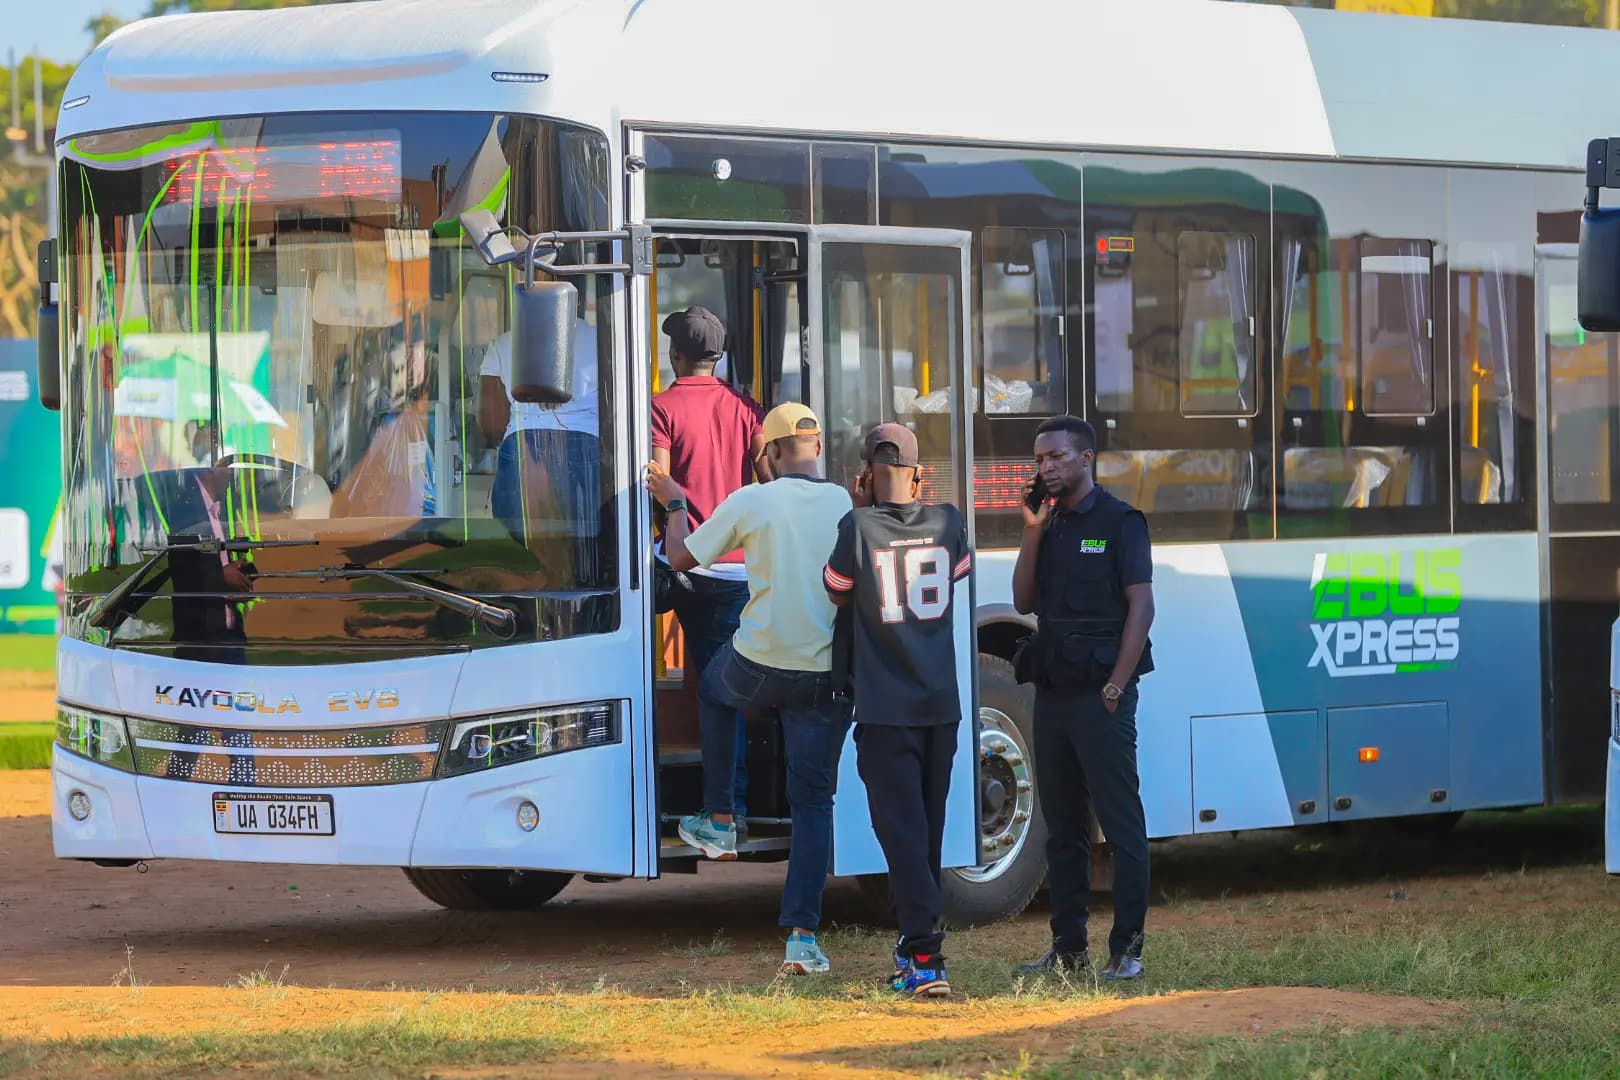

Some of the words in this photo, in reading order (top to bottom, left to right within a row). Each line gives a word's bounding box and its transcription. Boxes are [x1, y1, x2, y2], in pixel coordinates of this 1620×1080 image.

[872, 546, 950, 624] 18
[1310, 548, 1462, 620] EBUS
[1307, 616, 1460, 676] XPRESS
[155, 684, 301, 714] KAYOOLA
[237, 804, 258, 828] UA
[267, 804, 319, 829] 034FH
